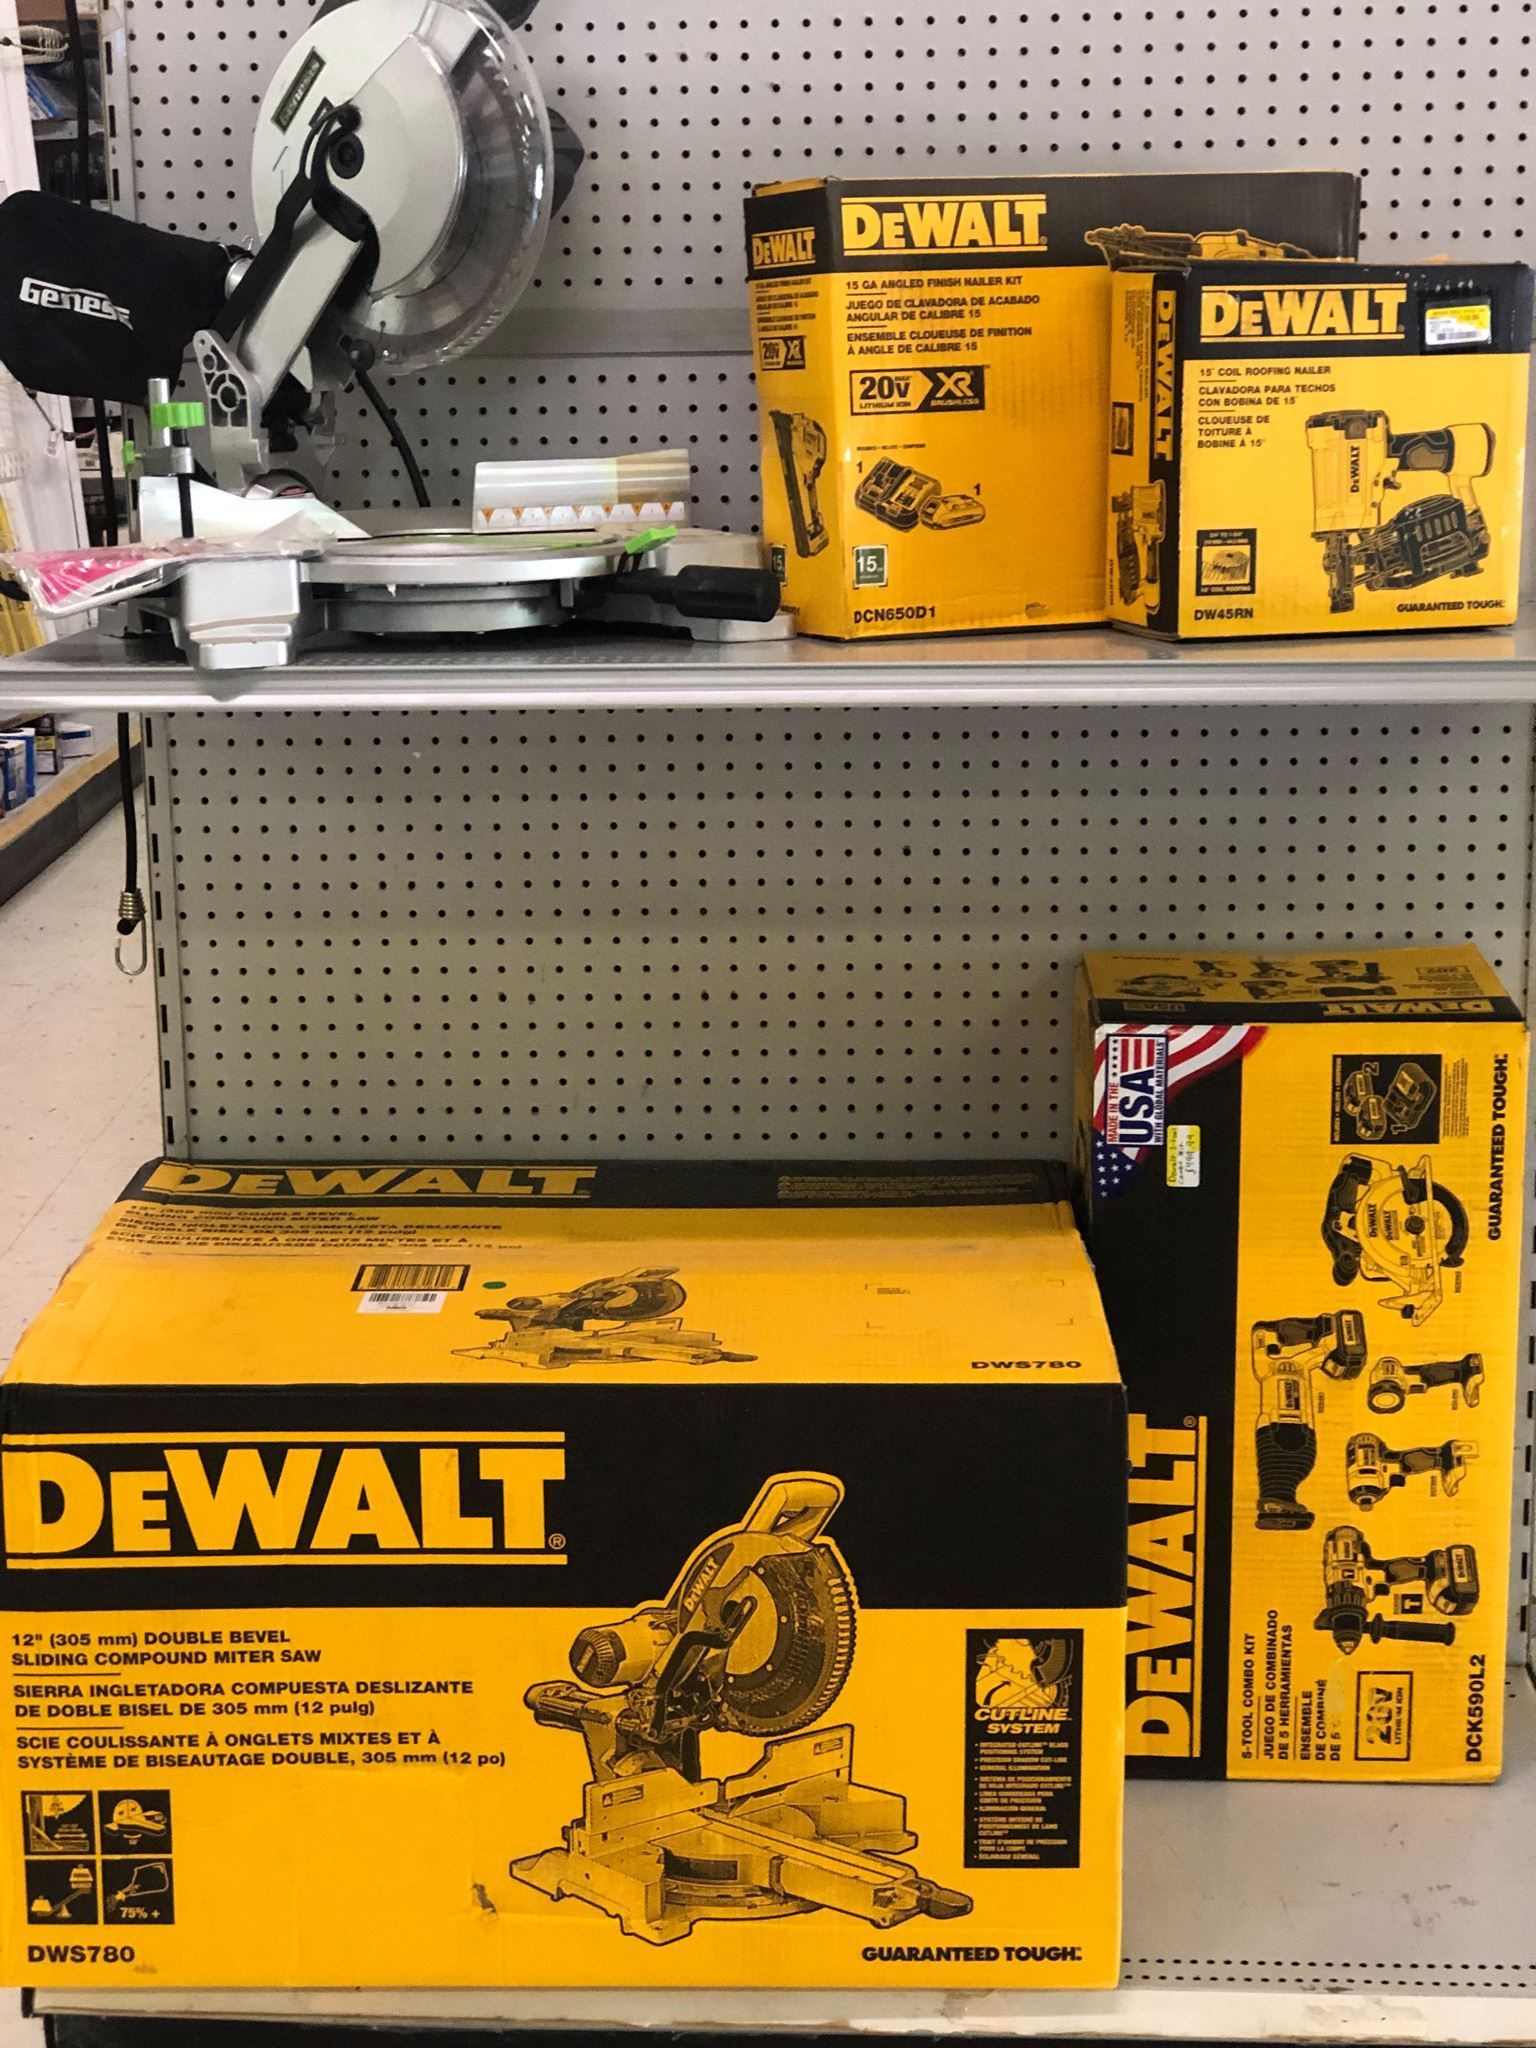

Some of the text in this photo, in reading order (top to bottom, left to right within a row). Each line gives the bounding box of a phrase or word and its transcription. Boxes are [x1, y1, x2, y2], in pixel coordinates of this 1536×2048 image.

[846, 276, 1022, 289] 15 GA ANGLED FINISH NAILER KIT
[846, 295, 1040, 310] JUEGO DE CLAVADORA DE ACABADO
[847, 309, 981, 321] ANGULAR DE CALIBRE 15
[847, 327, 1032, 341] ENSEMBLE CLOUEUSE DE FINITION
[858, 345, 894, 354] ANGLE
[898, 344, 912, 353] DE
[916, 342, 961, 352] CALIBRE
[965, 342, 977, 351] 15
[1218, 367, 1241, 376] COIL
[1245, 366, 1291, 376] ROOFING
[1295, 366, 1331, 375] NAILER
[935, 371, 975, 398] XR
[1199, 384, 1336, 395] CLAVADORA PARA TECHOS
[1199, 398, 1220, 407] CON
[1224, 397, 1262, 406] BOBINA
[1266, 397, 1279, 405] DE
[1198, 415, 1270, 425] CLOUEUSE DE
[1198, 428, 1241, 437] TOITURE
[1197, 439, 1235, 449] BOBINE
[856, 461, 863, 473] 1
[974, 483, 981, 496] 1
[857, 556, 877, 572] 15
[1397, 600, 1464, 612] GUARANTEED
[854, 606, 936, 624] DCN650D1
[1194, 608, 1253, 621] DW45RN
[1362, 1062, 1379, 1076] 2
[1154, 1042, 1165, 1142] WITH GLOBAL MATERIALS
[1108, 1083, 1119, 1142] MADE IN THE
[1119, 1069, 1154, 1143] USA
[1488, 1124, 1505, 1241] GUARANTEED
[971, 1360, 1082, 1369] DWS780
[12, 1630, 290, 1648] 12" (305 mm) DOUBLE BEVEL
[12, 1650, 321, 1666] SLIDING COMPOUND MITER SAW
[14, 1681, 473, 1697] SIERRA INGLETADORA COMPUESTA DESLIZANTE
[1264, 1610, 1278, 1759] JUEGO DE COMBINADO
[1278, 1625, 1293, 1760] DE 5 HERRAMIENTAS
[1242, 1633, 1255, 1759] 5-TOOL COMBO KIT
[15, 1701, 375, 1717] DE DOBLE BISEL DE 305 mm (12 pulg)
[1465, 1654, 1485, 1761] DCK590L2
[987, 1723, 1061, 1734] SYSTEM
[1301, 1691, 1312, 1760] ENSEMBLE
[16, 1729, 440, 1749] SCIE COULISSANTE À ONGLETS MIXTES ET À
[18, 1751, 505, 1768] SYSTÈME DE BISEAUTAGE DOUBLE, 305 mm (12 po)
[1316, 1744, 1326, 1760] DE
[1330, 1744, 1341, 1761] DE
[120, 1907, 148, 1919] 75%
[28, 1945, 135, 1963] DWS780
[862, 1946, 1000, 1961] GUARANTEED
